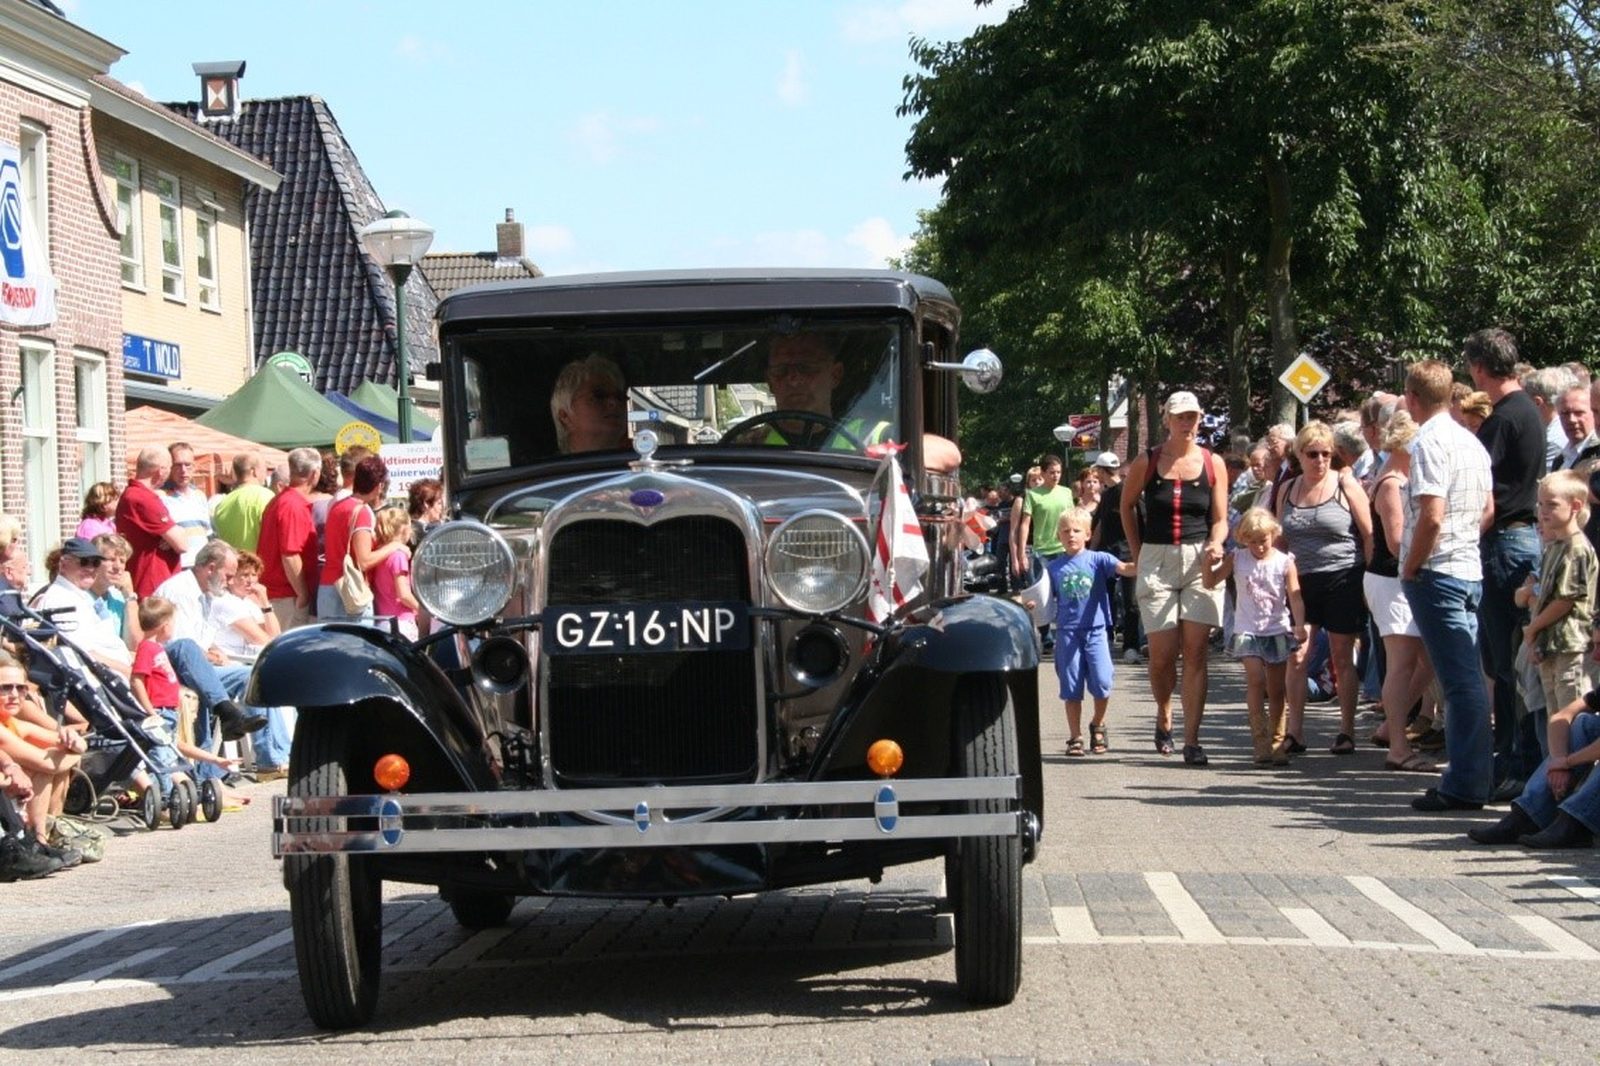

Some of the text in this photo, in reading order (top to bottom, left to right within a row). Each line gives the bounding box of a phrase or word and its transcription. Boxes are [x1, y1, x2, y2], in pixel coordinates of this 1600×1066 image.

[153, 341, 179, 376] WOLD
[381, 455, 443, 465] ldtimerdag
[389, 467, 442, 477] uinerwol
[556, 608, 735, 648] GZ-16-NP
